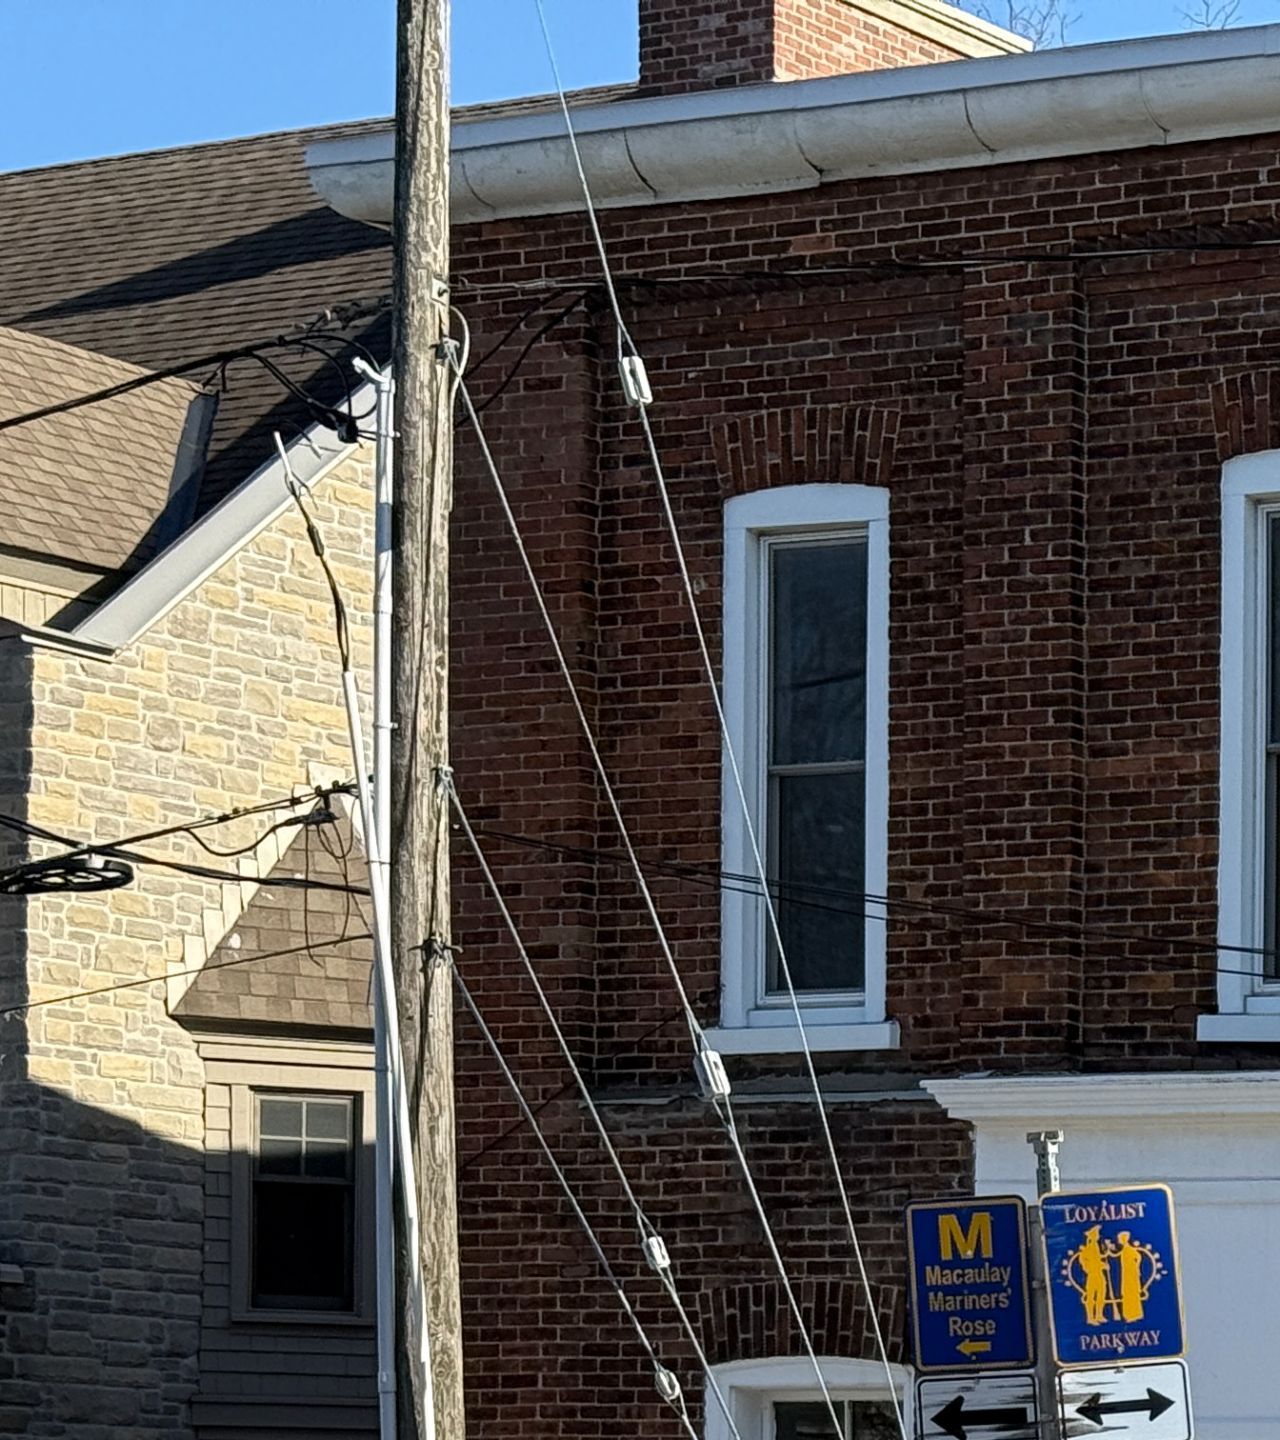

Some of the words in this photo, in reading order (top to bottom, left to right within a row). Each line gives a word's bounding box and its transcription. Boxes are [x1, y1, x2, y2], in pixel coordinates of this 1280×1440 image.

[1064, 1201, 1147, 1224] LOYALIST
[938, 1212, 993, 1259] M
[925, 1262, 1011, 1286] Macaulay
[928, 1289, 1012, 1311] Mariners'
[948, 1316, 997, 1337] Rose
[1079, 1330, 1162, 1351] PARKWAY
